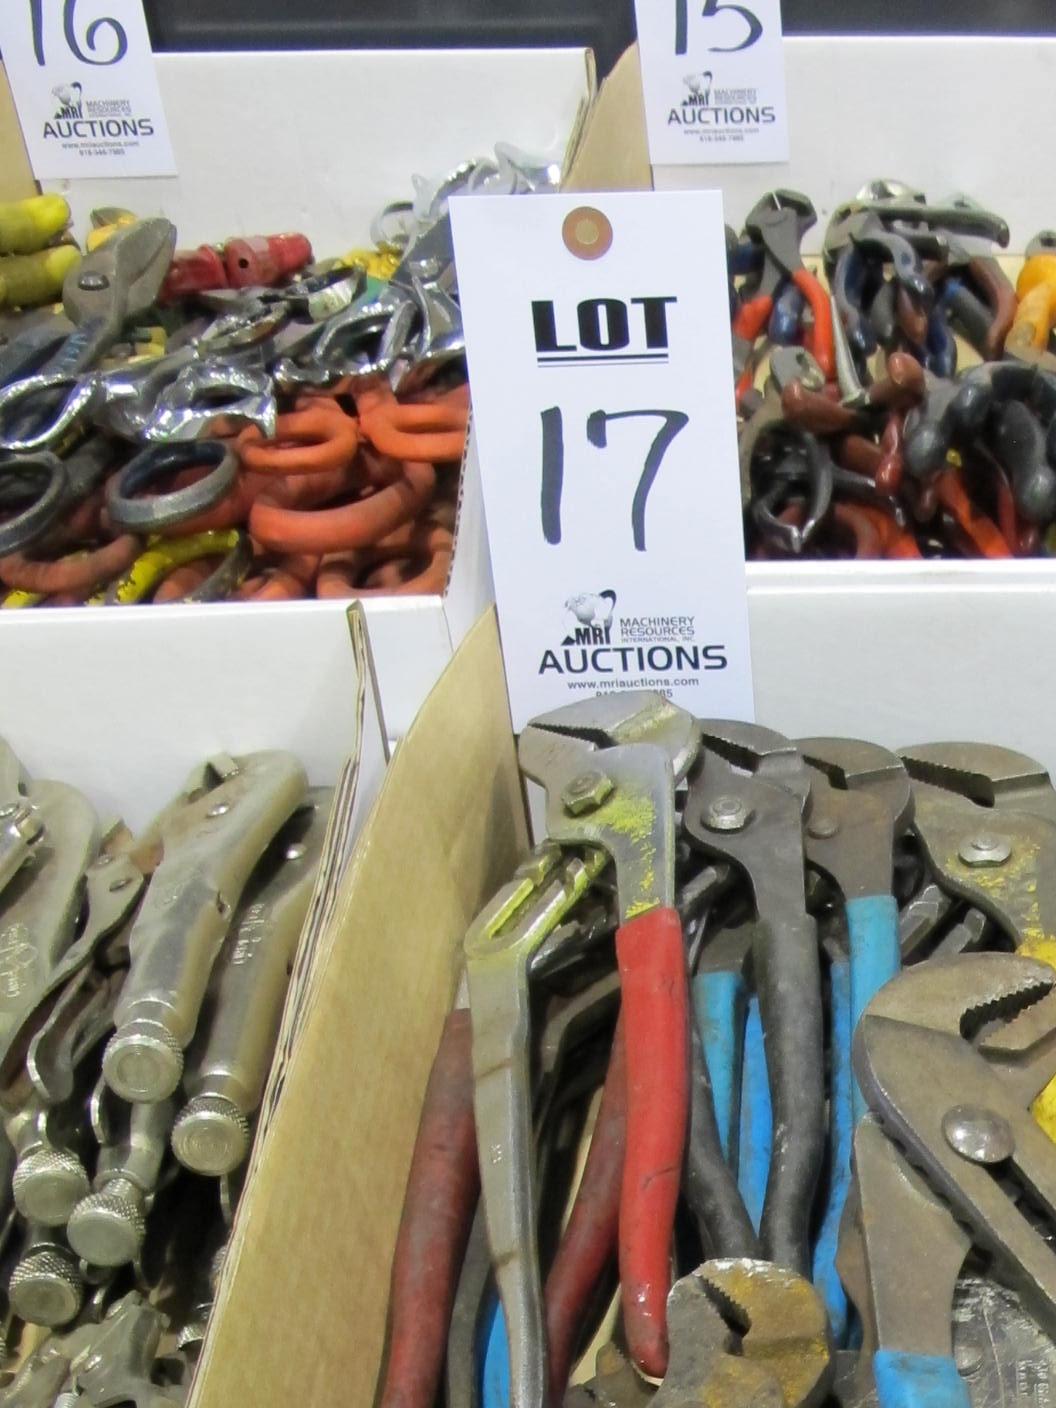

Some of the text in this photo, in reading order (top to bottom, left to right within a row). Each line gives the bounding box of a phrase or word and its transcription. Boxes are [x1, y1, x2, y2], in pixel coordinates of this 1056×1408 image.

[675, 0, 763, 55] 15
[668, 106, 776, 125] AUCTIONS
[43, 118, 154, 139] AUCTIONS
[531, 296, 677, 353] LOT
[540, 405, 690, 552] 17
[620, 616, 695, 627] MACHINERY
[620, 626, 695, 637] RESOURCES
[574, 625, 611, 646] MRI
[538, 645, 728, 674] AUCTIONS
[567, 677, 699, 690] www.mriauctions.com
